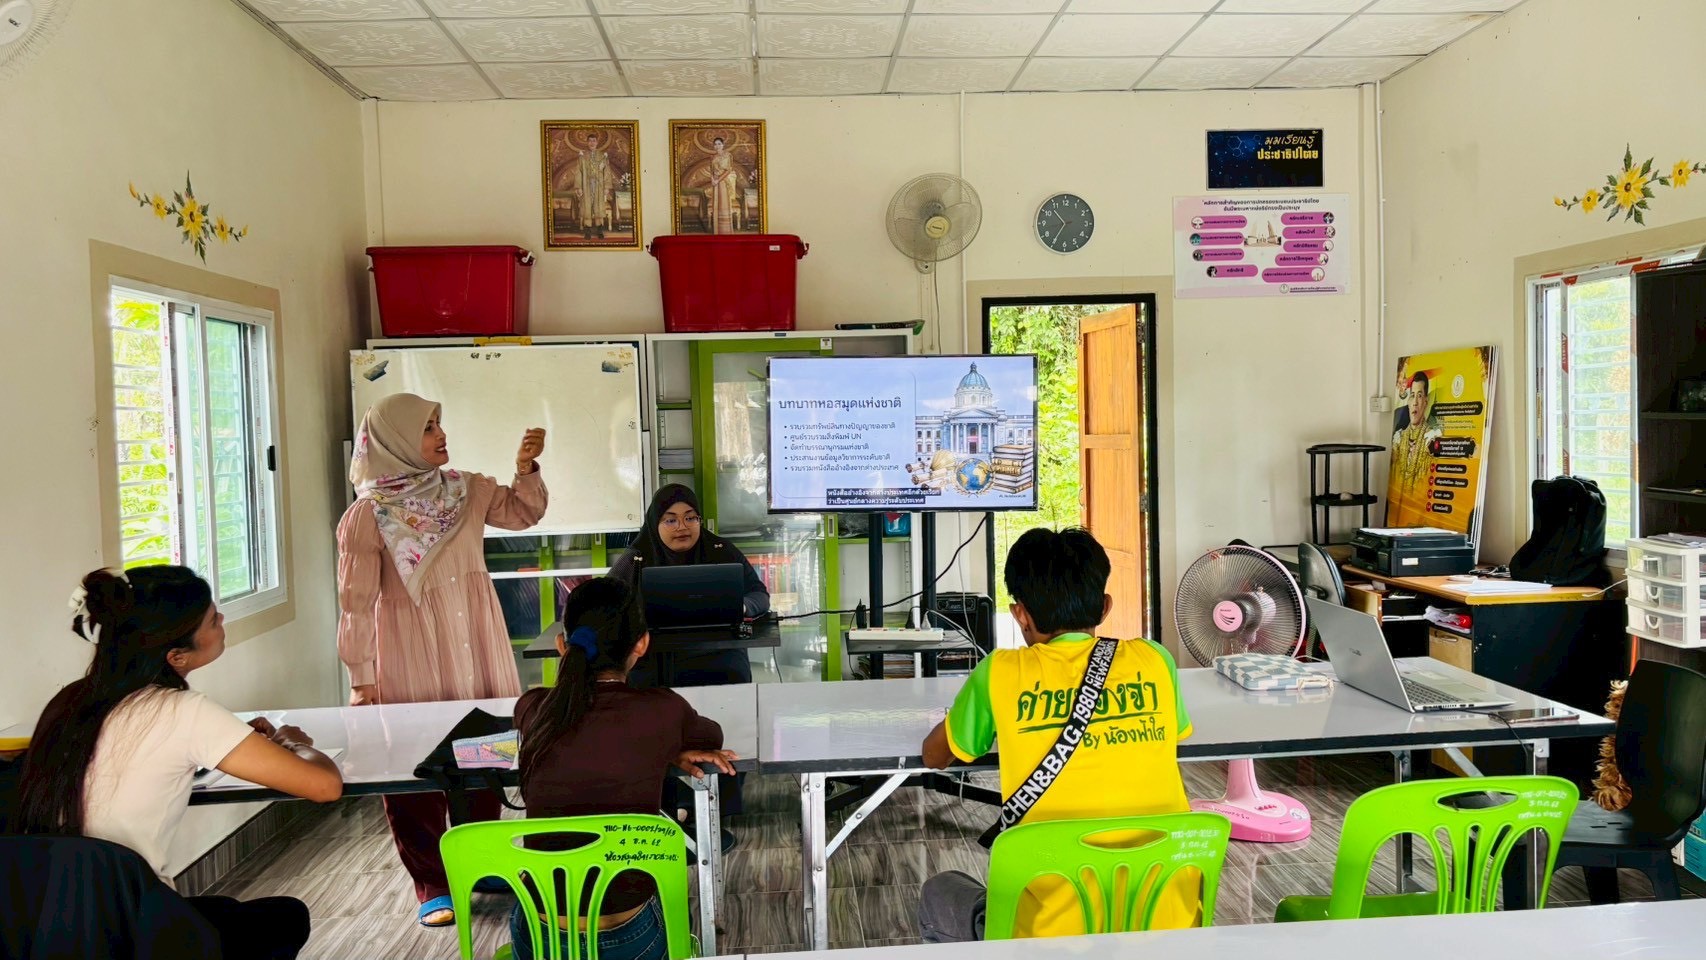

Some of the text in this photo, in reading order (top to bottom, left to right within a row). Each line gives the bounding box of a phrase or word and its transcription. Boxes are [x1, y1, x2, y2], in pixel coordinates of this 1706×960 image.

[1264, 132, 1318, 149] มุมเรียนรู้
[1257, 147, 1319, 160] ประชาธิปไตย
[778, 397, 902, 412] บทบาทหอสมุดแห่งชาติ
[790, 422, 896, 431] รวบรวมทรัพย์สินทางปัญญาของชาติ
[790, 432, 850, 442] ศูนย์รวบรวมสิ่งพิมพ์
[790, 443, 870, 452] จัดทำบรรณานุกรมแห่งชาติ
[790, 454, 891, 462] ประสานงานข้อมูลวิชาการระดับชาติ
[1083, 716, 1165, 749] By น้องฟ้าใส
